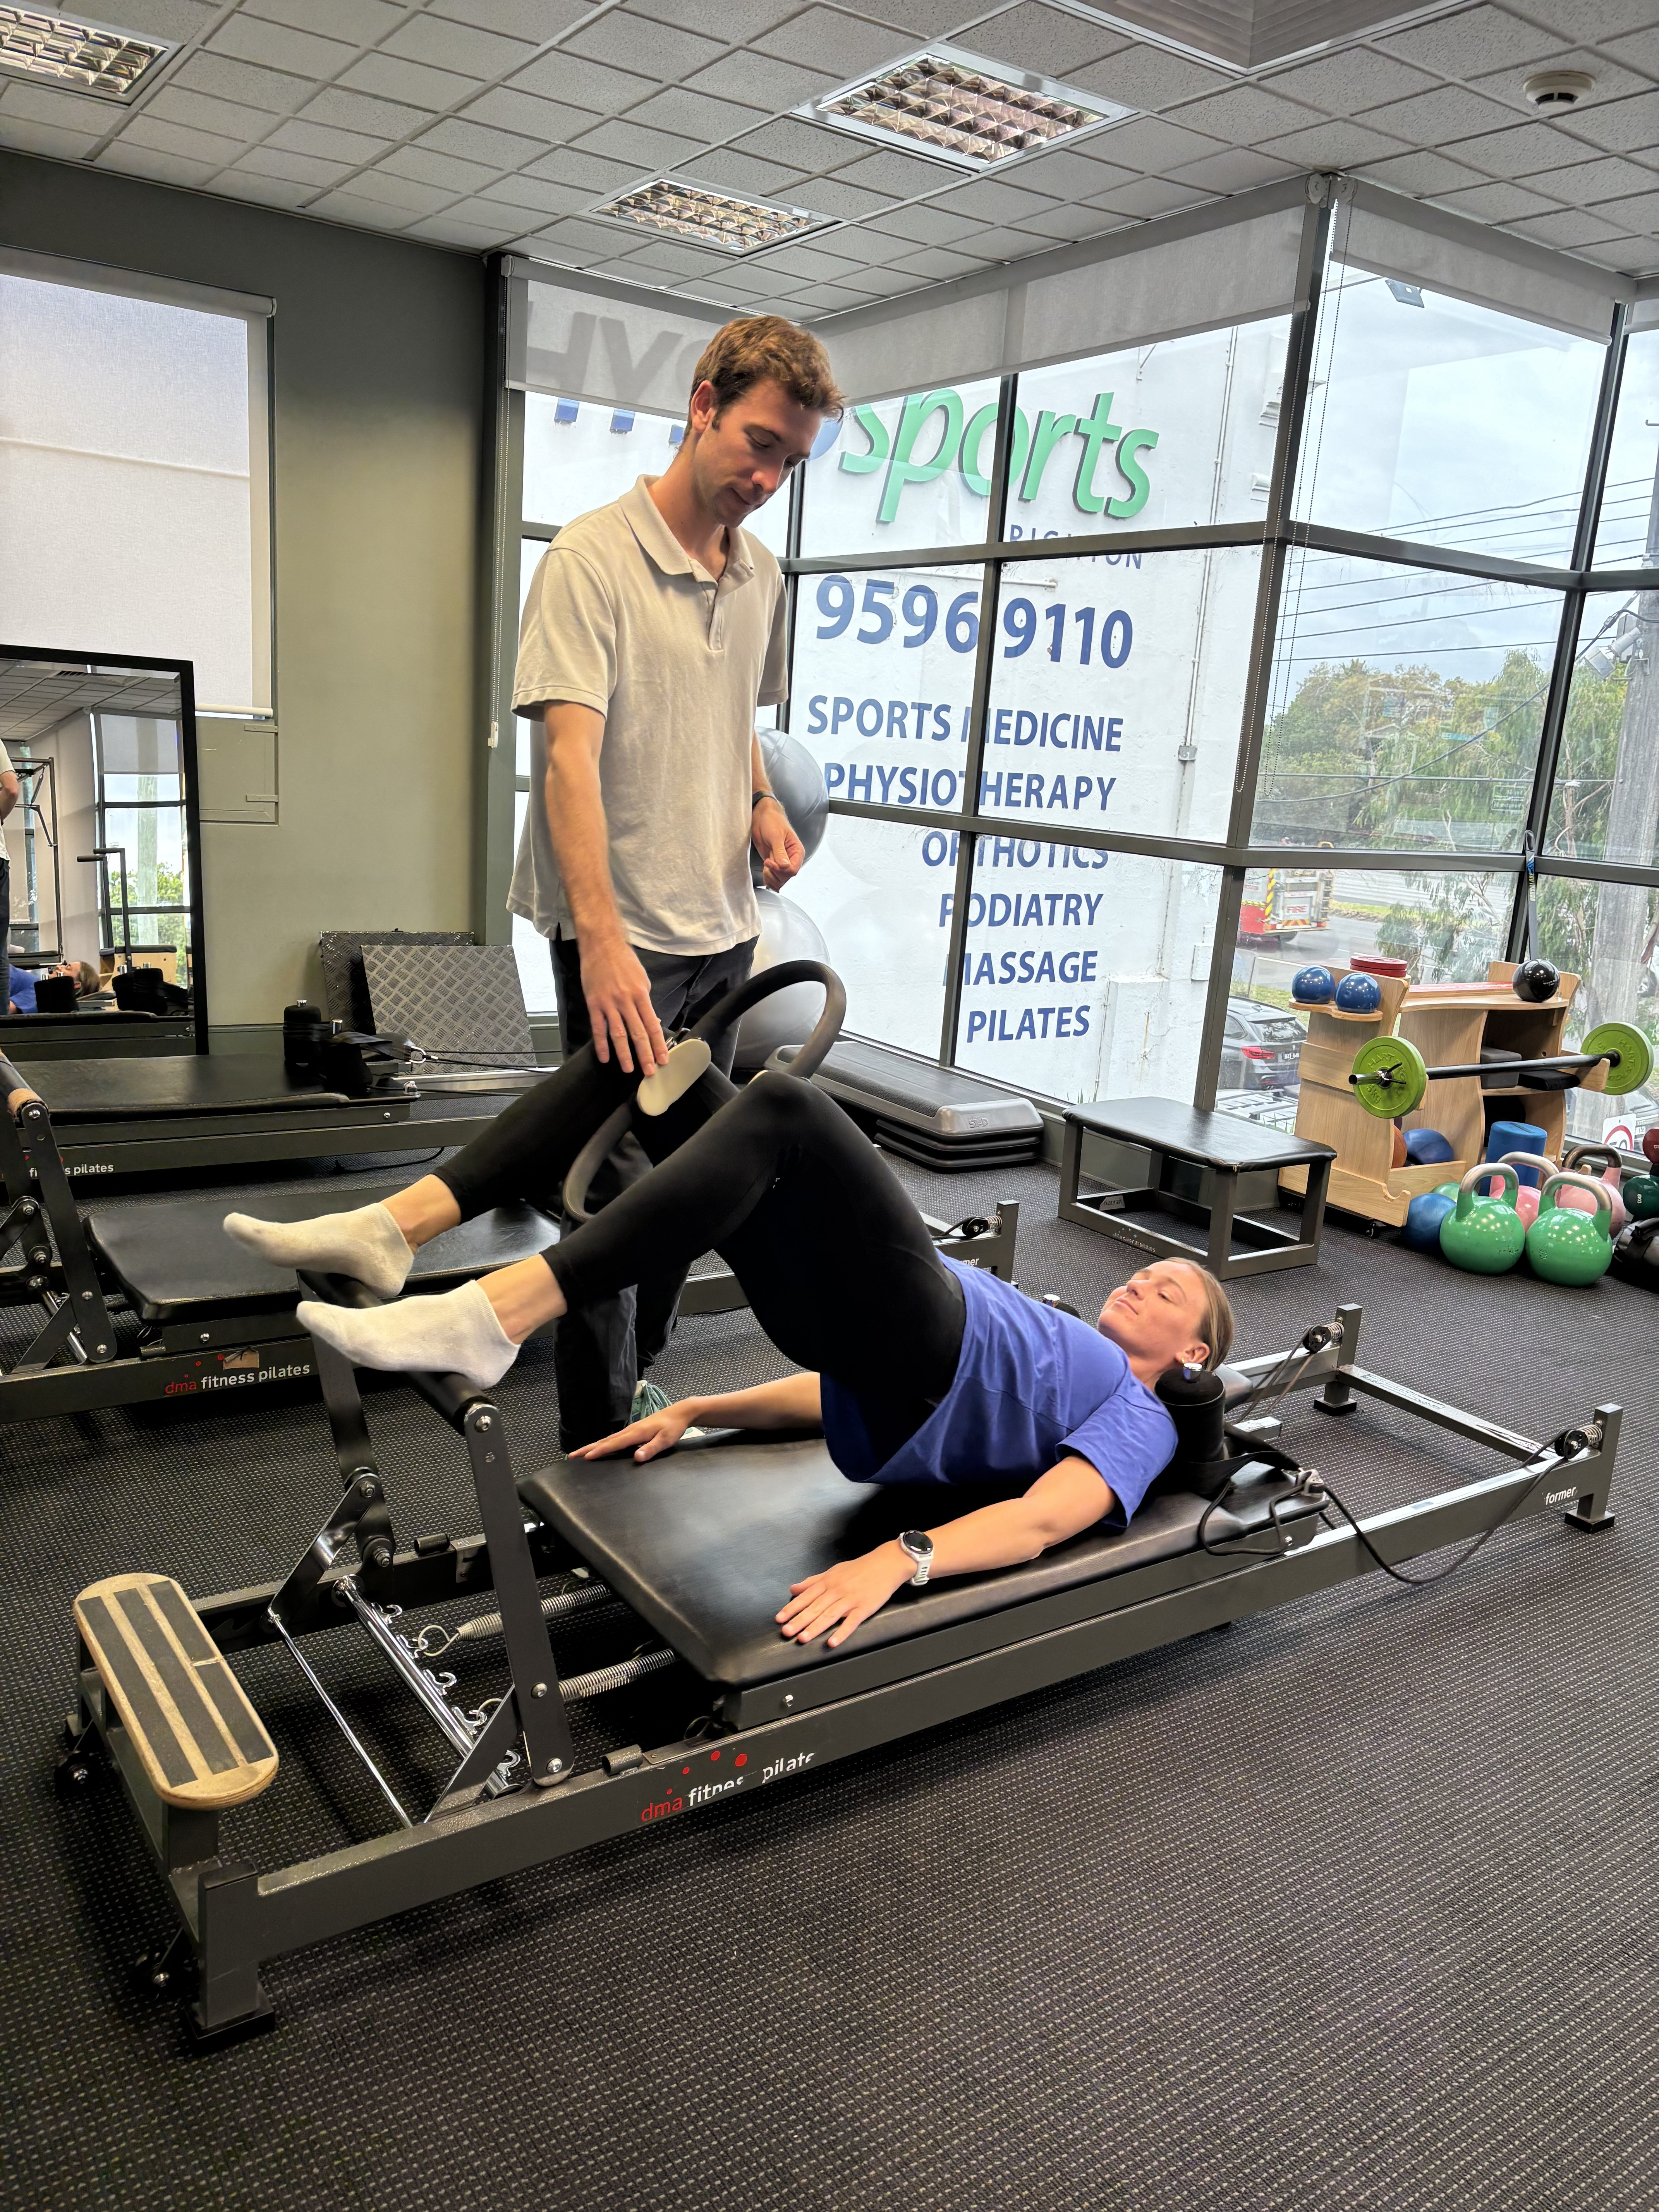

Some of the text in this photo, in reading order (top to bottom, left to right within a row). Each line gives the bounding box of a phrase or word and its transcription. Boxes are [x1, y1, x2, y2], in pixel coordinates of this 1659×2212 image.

[838, 388, 1159, 524] sports
[816, 575, 1133, 668] 9596 9110
[807, 695, 951, 741] SPORTS
[824, 762, 1116, 811] PHYSIOHERAPY
[939, 893, 1104, 927] PODIATRY
[967, 1005, 1091, 1043] PILATES
[74, 1164, 114, 1175] pilates
[165, 1364, 310, 1394] dma fitness pilates
[1545, 1486, 1577, 1505] former
[641, 1797, 682, 1821] dma
